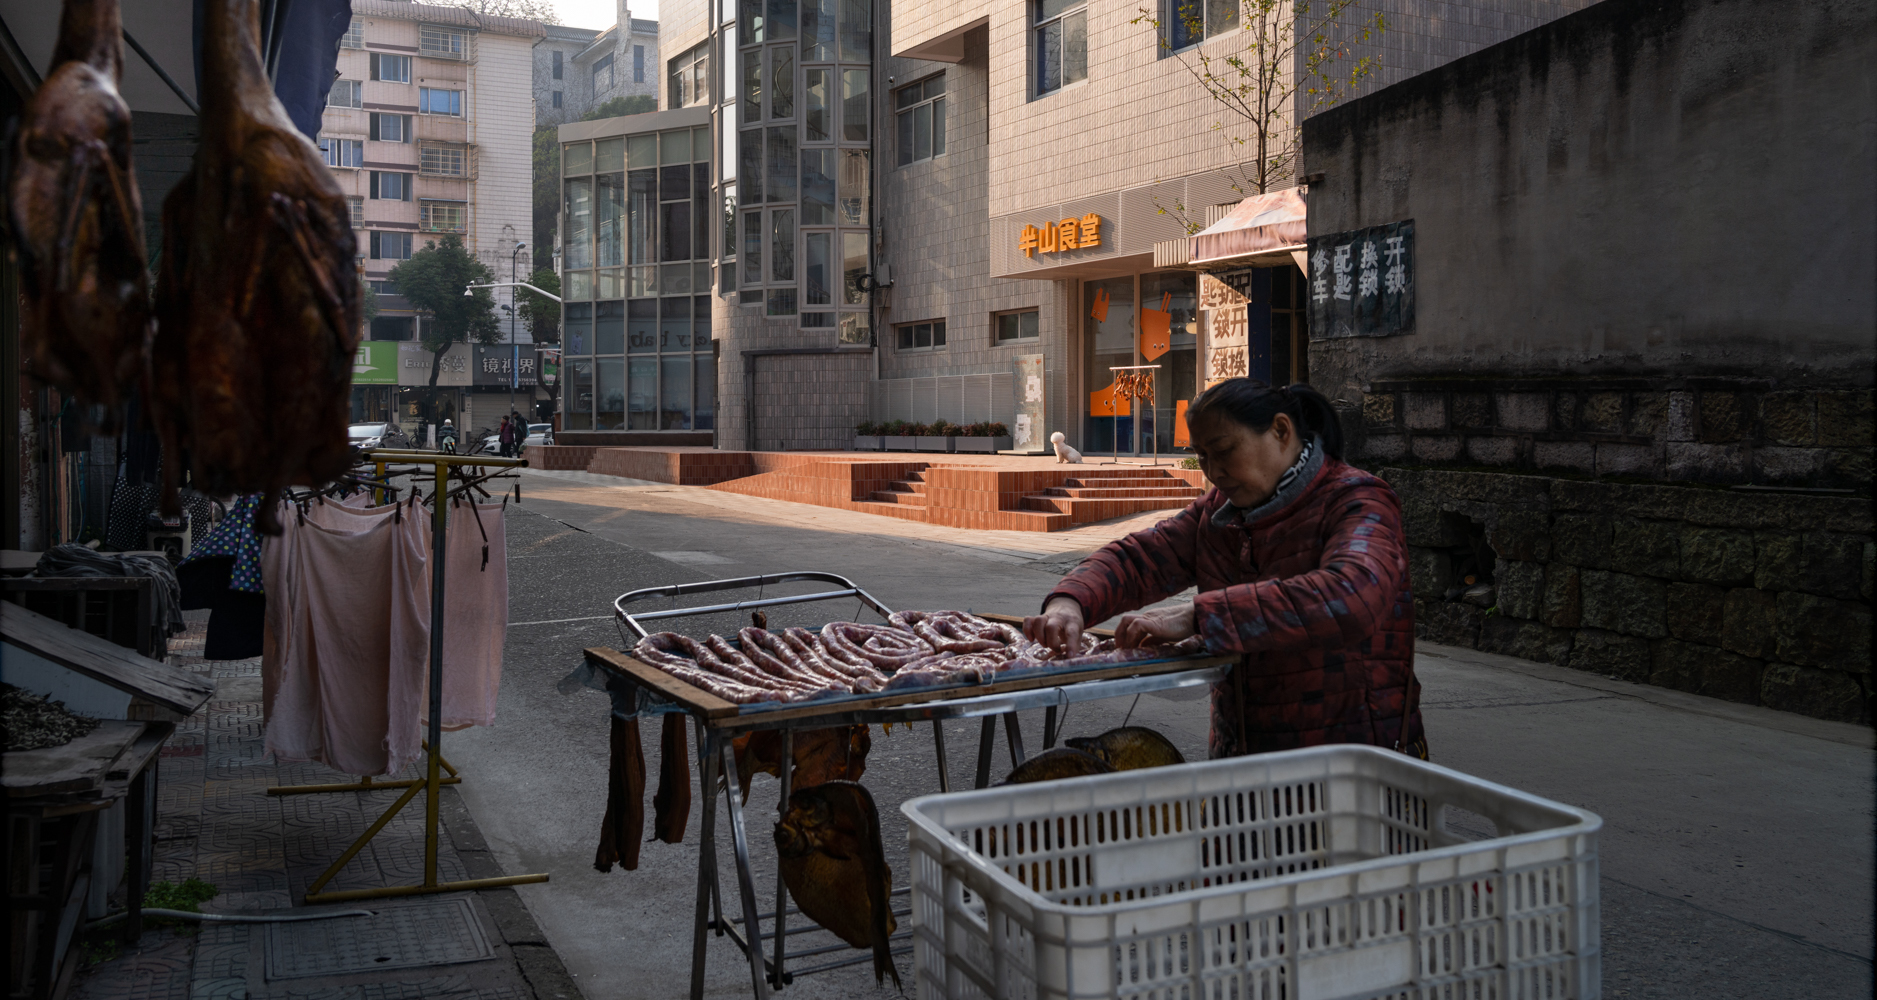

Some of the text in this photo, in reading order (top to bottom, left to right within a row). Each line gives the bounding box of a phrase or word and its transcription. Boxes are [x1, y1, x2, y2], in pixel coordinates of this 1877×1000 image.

[1018, 213, 1102, 258] 半山食堂
[1311, 248, 1330, 304] 修车
[1333, 244, 1353, 301] 配匙
[1359, 241, 1379, 297] 换锁
[1384, 235, 1406, 294] 开锁
